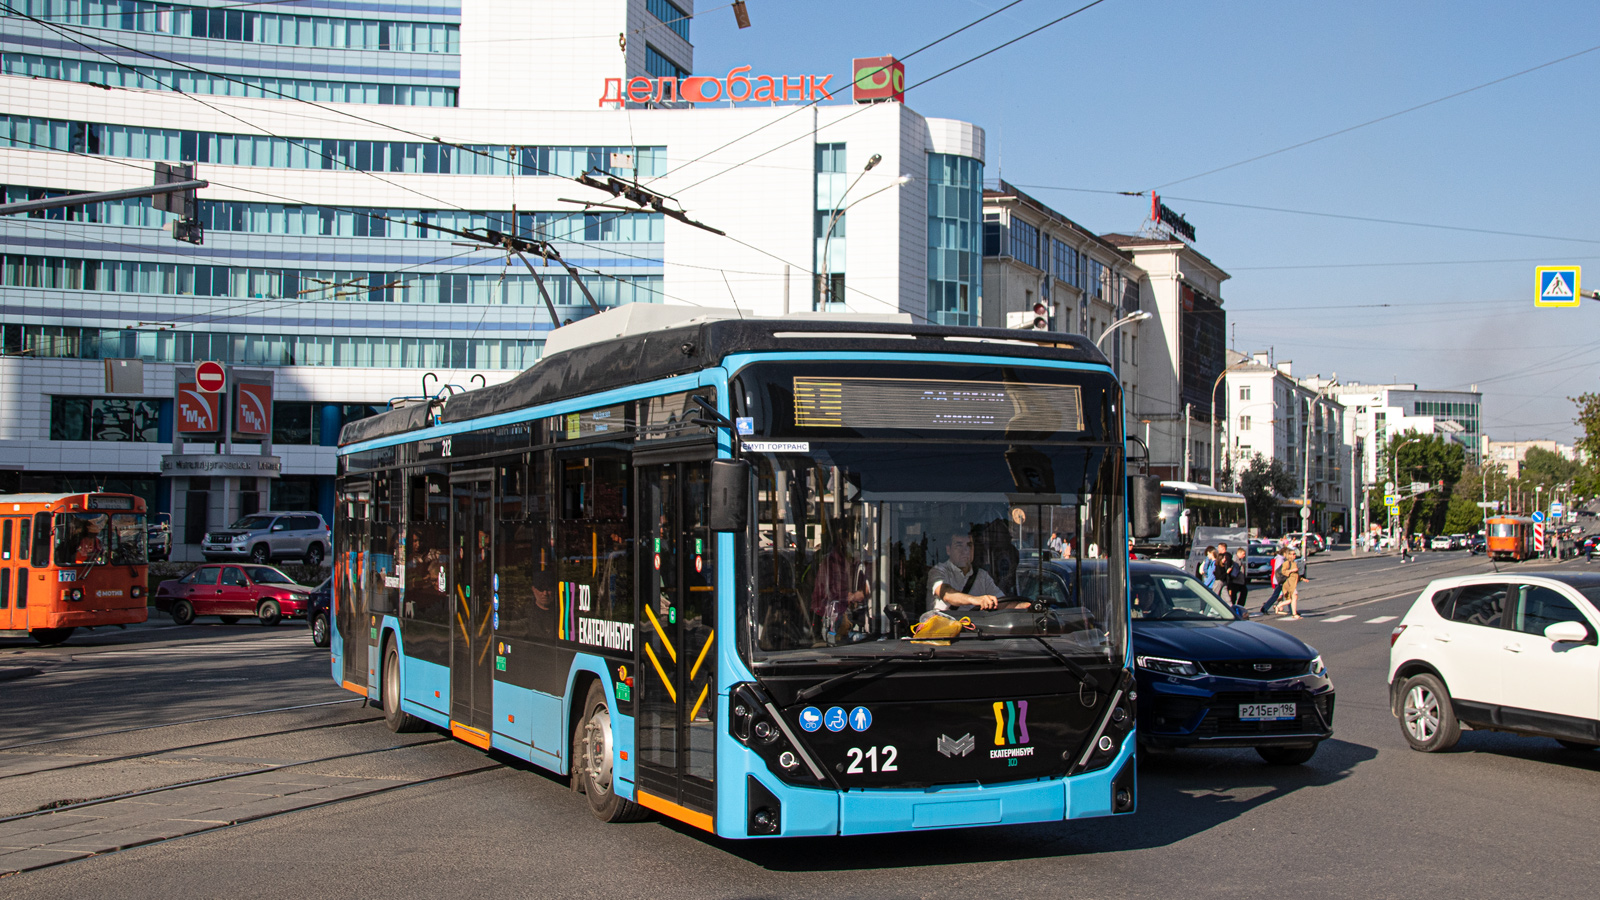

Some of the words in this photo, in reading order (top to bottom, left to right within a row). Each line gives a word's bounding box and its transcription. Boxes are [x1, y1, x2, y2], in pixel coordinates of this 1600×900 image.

[180, 403, 207, 429] ТМК
[241, 404, 262, 431] ТМК
[441, 438, 452, 457] 212
[60, 572, 76, 582] 170
[578, 616, 635, 653] ЕКАТЕРИНБУРГ
[1280, 703, 1294, 713] 196
[846, 744, 898, 775] 212
[989, 746, 1035, 759] ЕКАТЕРИНБУРГ
